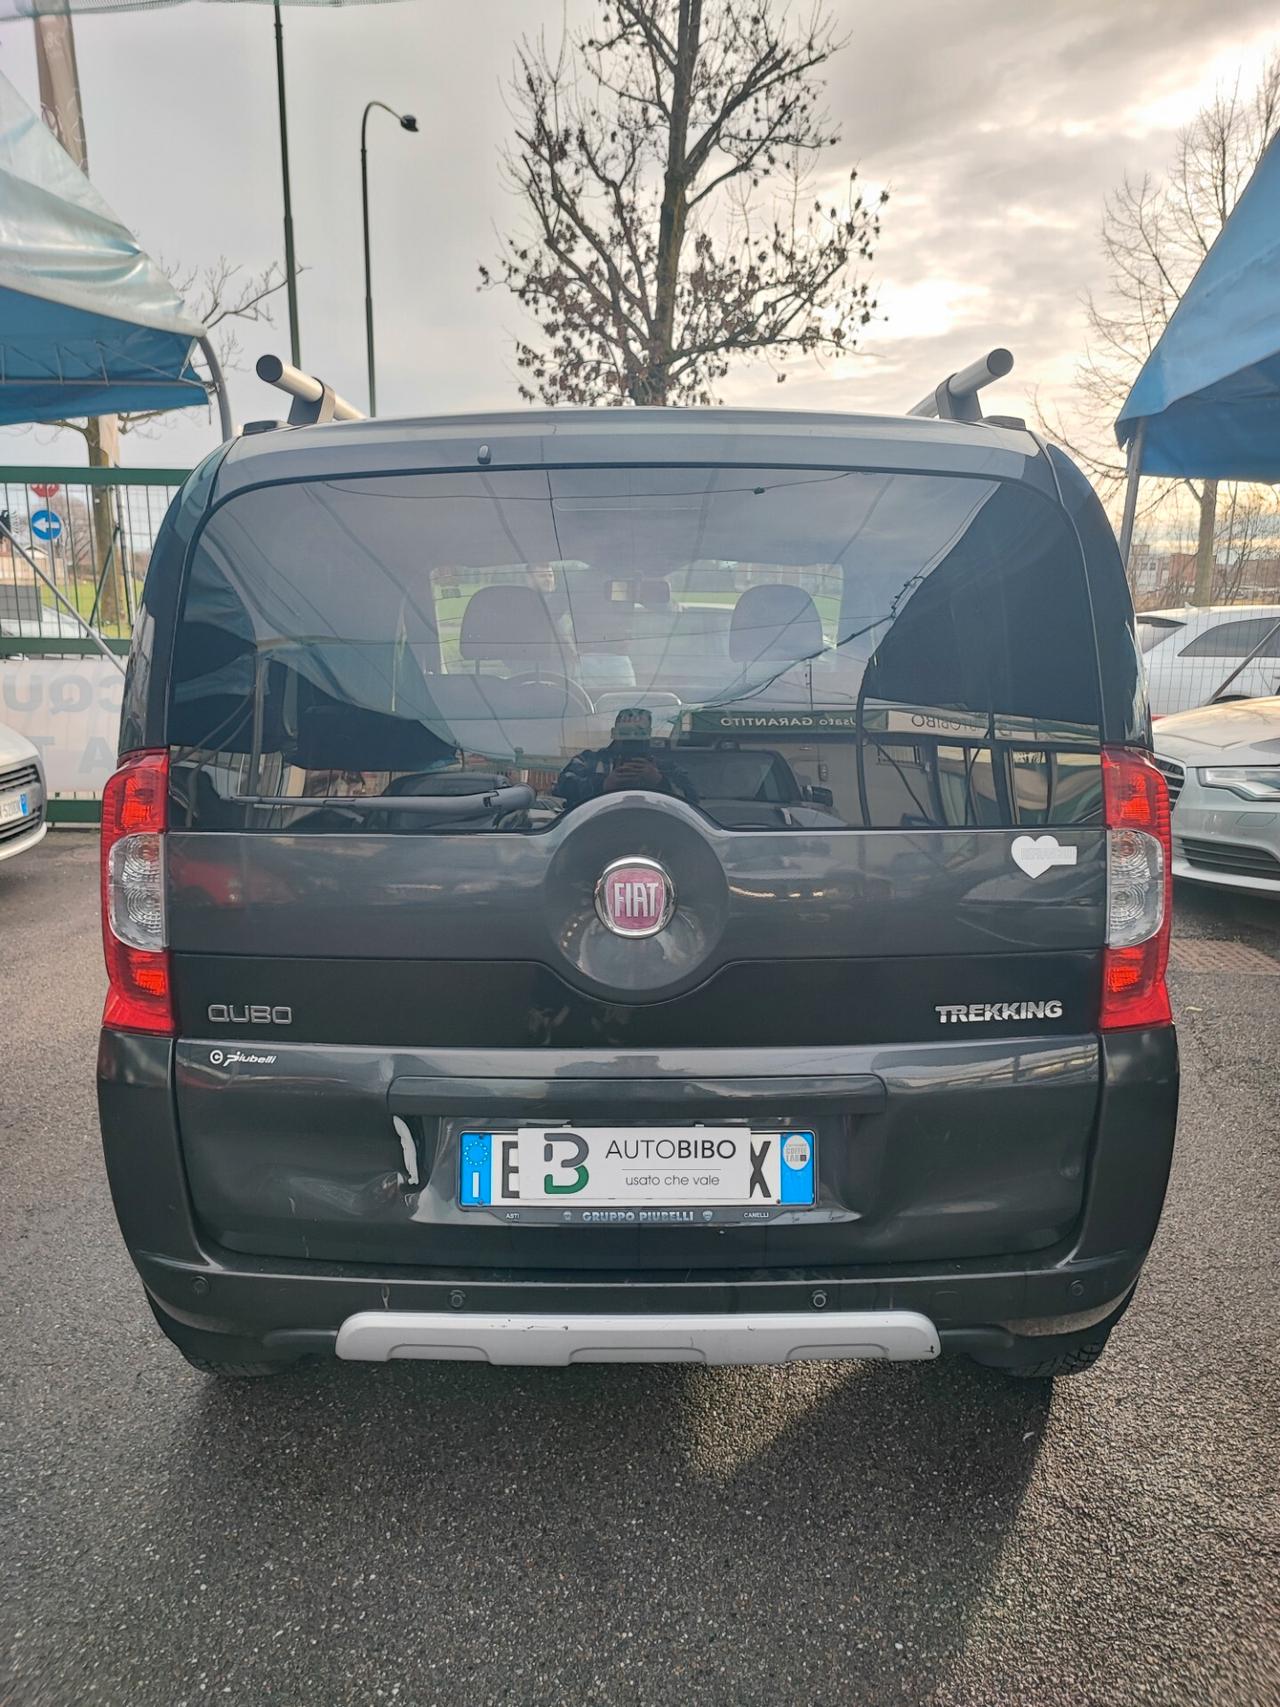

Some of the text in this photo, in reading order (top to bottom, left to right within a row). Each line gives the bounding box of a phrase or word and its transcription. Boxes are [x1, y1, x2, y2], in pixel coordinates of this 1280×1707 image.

[613, 882, 659, 917] FIAT
[208, 1004, 292, 1025] QUBO
[935, 1000, 1063, 1023] TREKKING
[605, 1139, 737, 1160] AUTOBIBO
[625, 1174, 720, 1186] usato che vale
[582, 1211, 694, 1222] GRUPPO PIUBELLI
